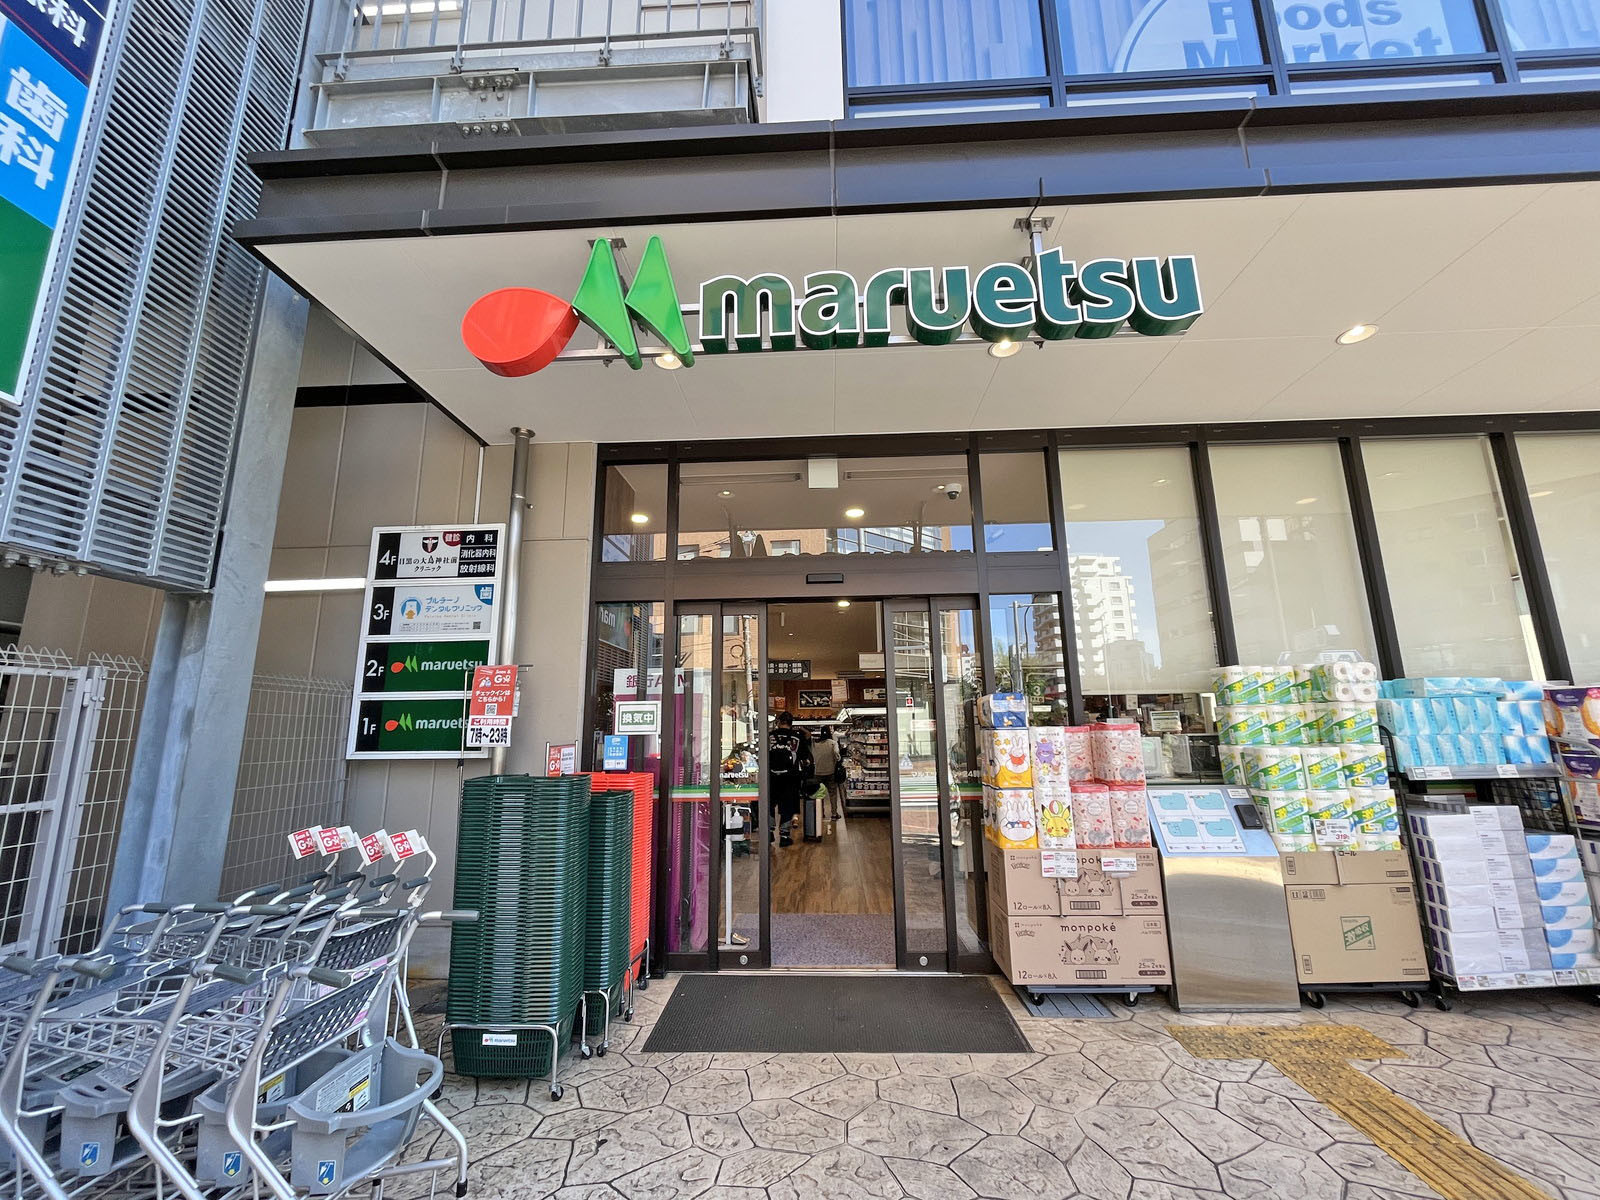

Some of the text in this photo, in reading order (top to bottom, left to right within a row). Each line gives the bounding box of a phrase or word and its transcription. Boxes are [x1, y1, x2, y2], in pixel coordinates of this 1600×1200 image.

[26, 0, 86, 48] 科
[0, 66, 69, 190] 歯科
[700, 247, 1205, 350] maruetsu
[379, 550, 396, 566] 4F
[460, 549, 496, 559] 消化器内科
[414, 565, 442, 573] クリニック
[460, 563, 495, 573] 放射線科
[373, 604, 390, 620] 3F
[366, 660, 385, 676] 2F
[622, 712, 654, 724] 換気中
[362, 718, 377, 735] 1F
[1060, 922, 1116, 933] monpoké
